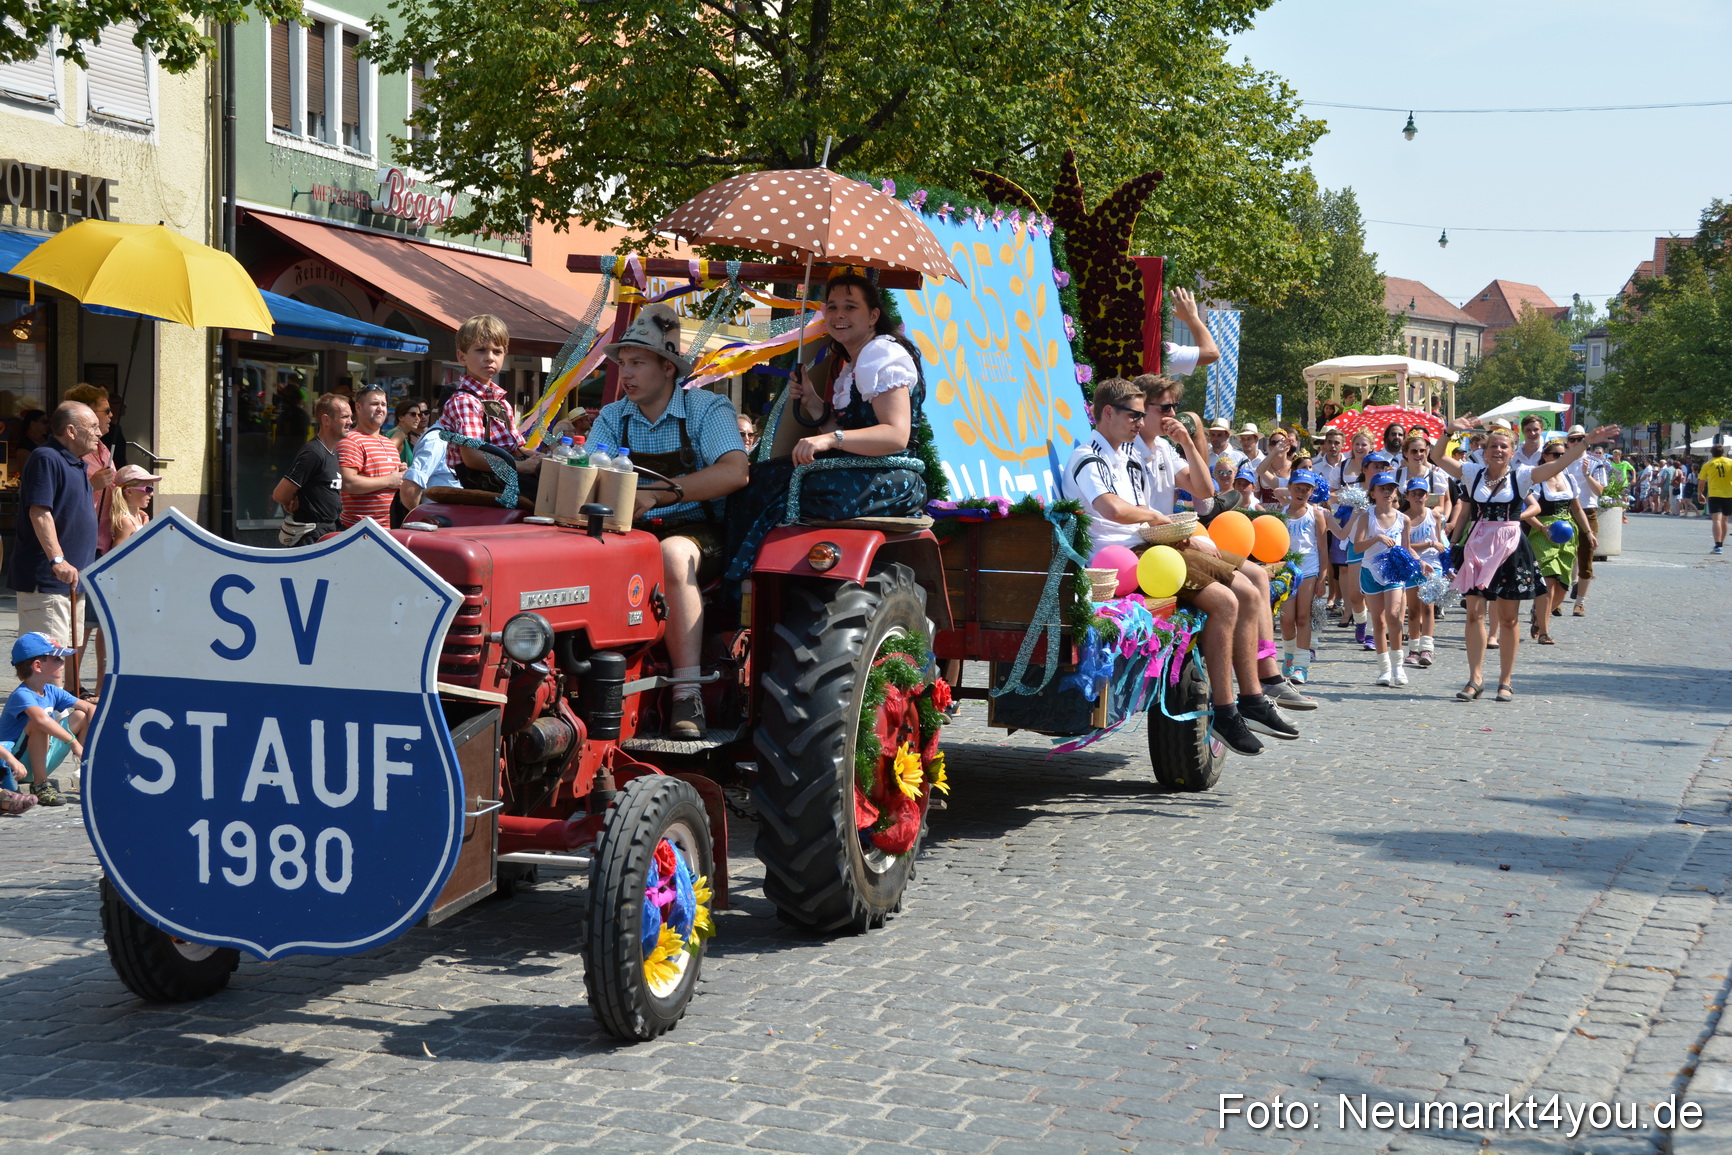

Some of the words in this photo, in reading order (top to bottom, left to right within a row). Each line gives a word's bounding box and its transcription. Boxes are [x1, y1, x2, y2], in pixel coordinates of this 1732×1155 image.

[0, 158, 119, 222] OTHEKE
[312, 183, 370, 211] METZGEREI
[951, 241, 1010, 352] 35
[210, 574, 329, 665] SV
[127, 708, 421, 811] STAUF
[188, 819, 353, 894] 1980
